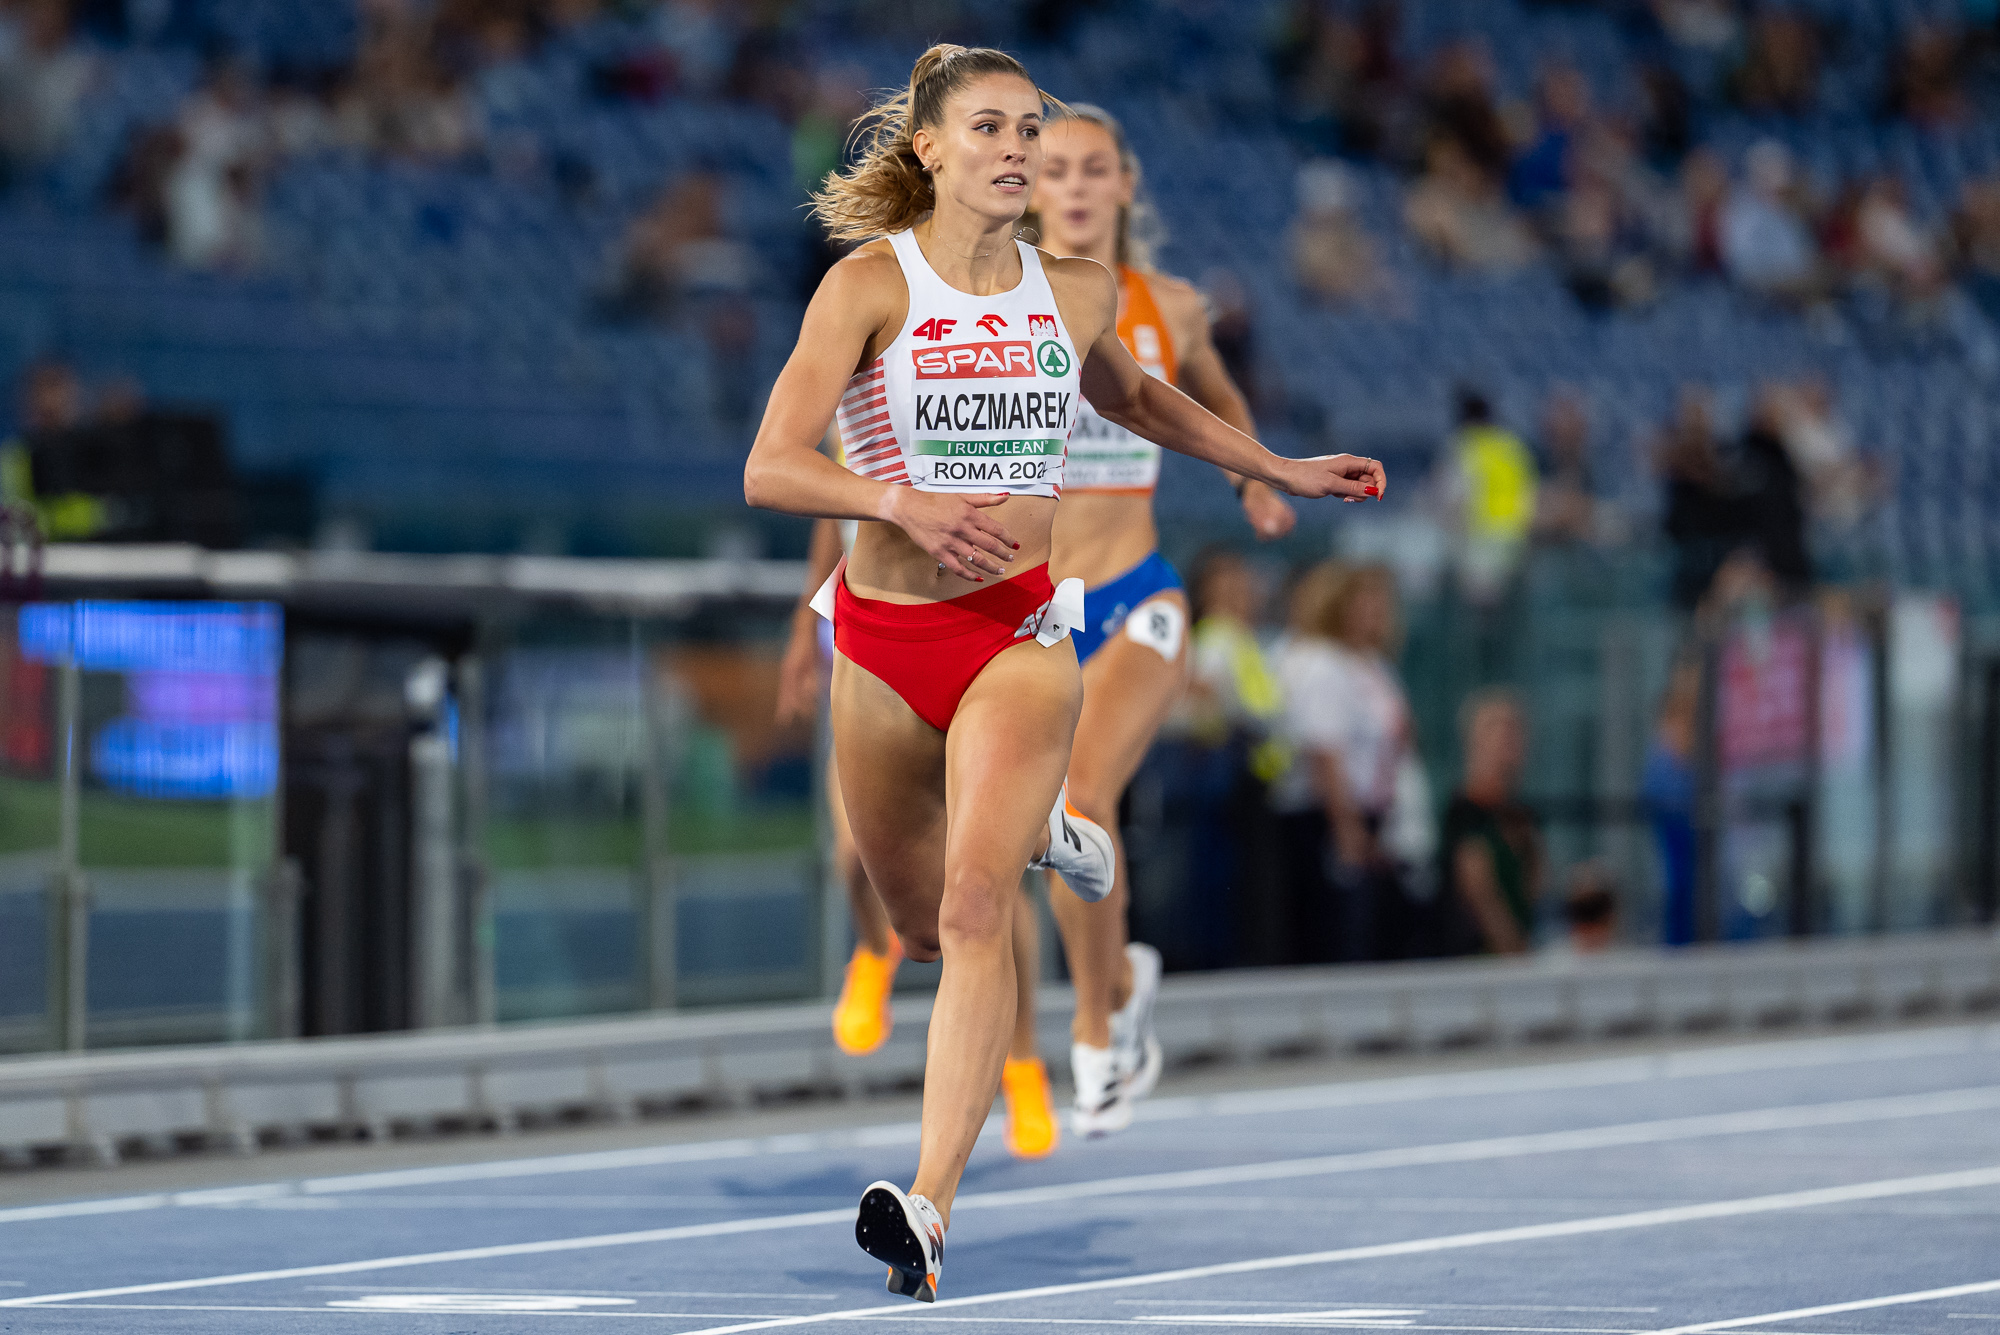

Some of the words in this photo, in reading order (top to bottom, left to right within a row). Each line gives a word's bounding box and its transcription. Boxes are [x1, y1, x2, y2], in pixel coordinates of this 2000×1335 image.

[912, 317, 958, 341] 4F
[916, 346, 1032, 374] SPAR
[915, 391, 1071, 431] KACZMAREK
[947, 443, 952, 455] I
[955, 442, 990, 455] RUN
[993, 440, 1044, 455] CLEAN
[934, 461, 1004, 480] ROMA
[1009, 461, 1047, 479] 202
